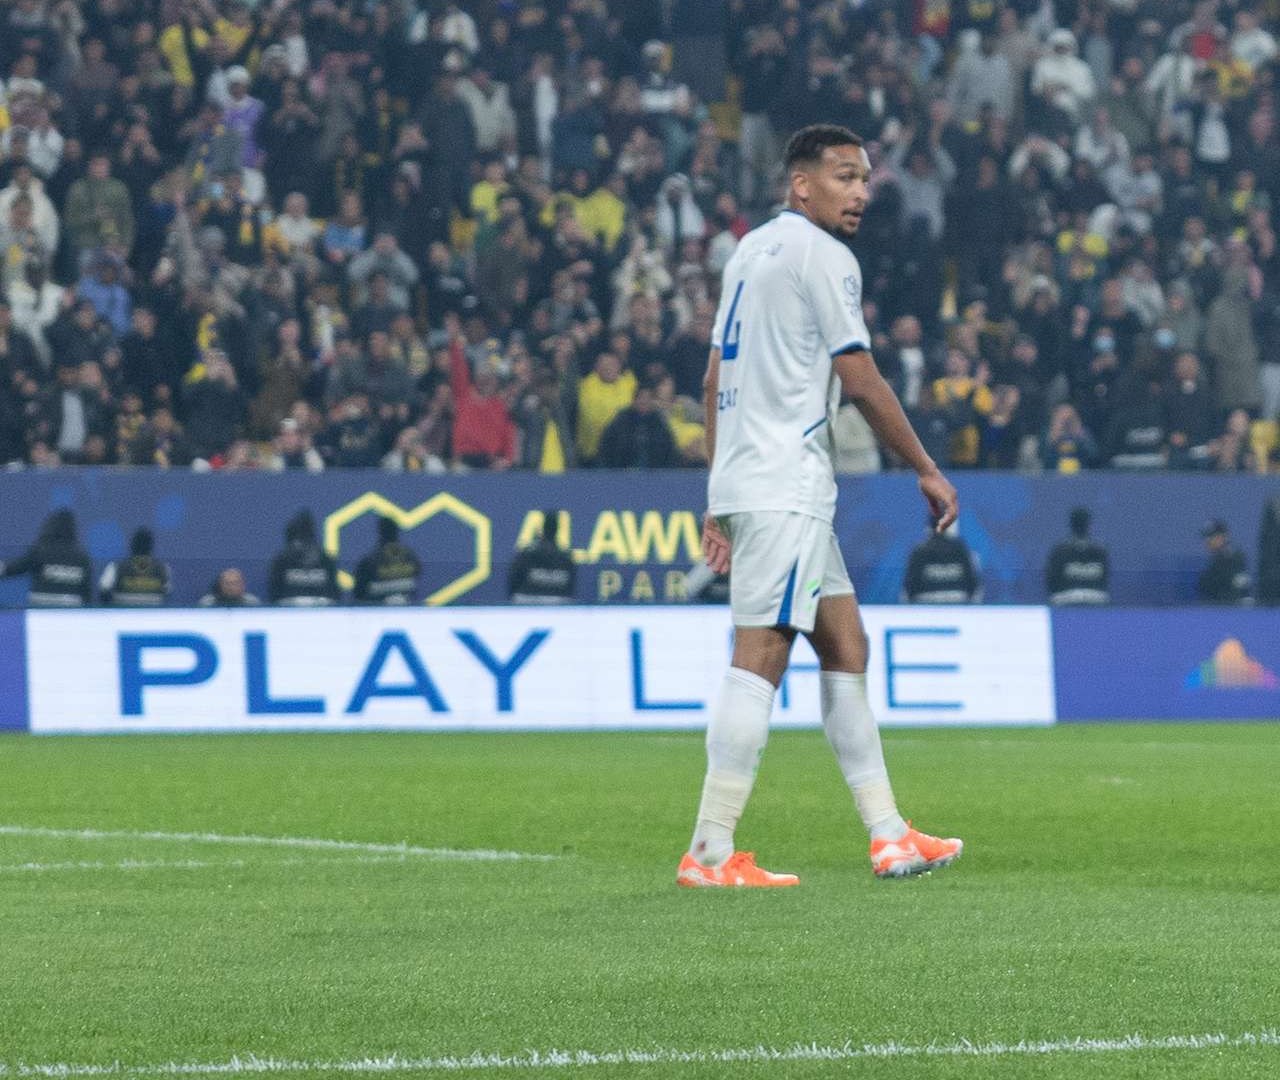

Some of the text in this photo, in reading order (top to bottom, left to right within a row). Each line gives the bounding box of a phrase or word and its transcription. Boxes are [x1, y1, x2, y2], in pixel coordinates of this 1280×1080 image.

[598, 570, 690, 602] PAR
[117, 627, 964, 717] PLAY LE
